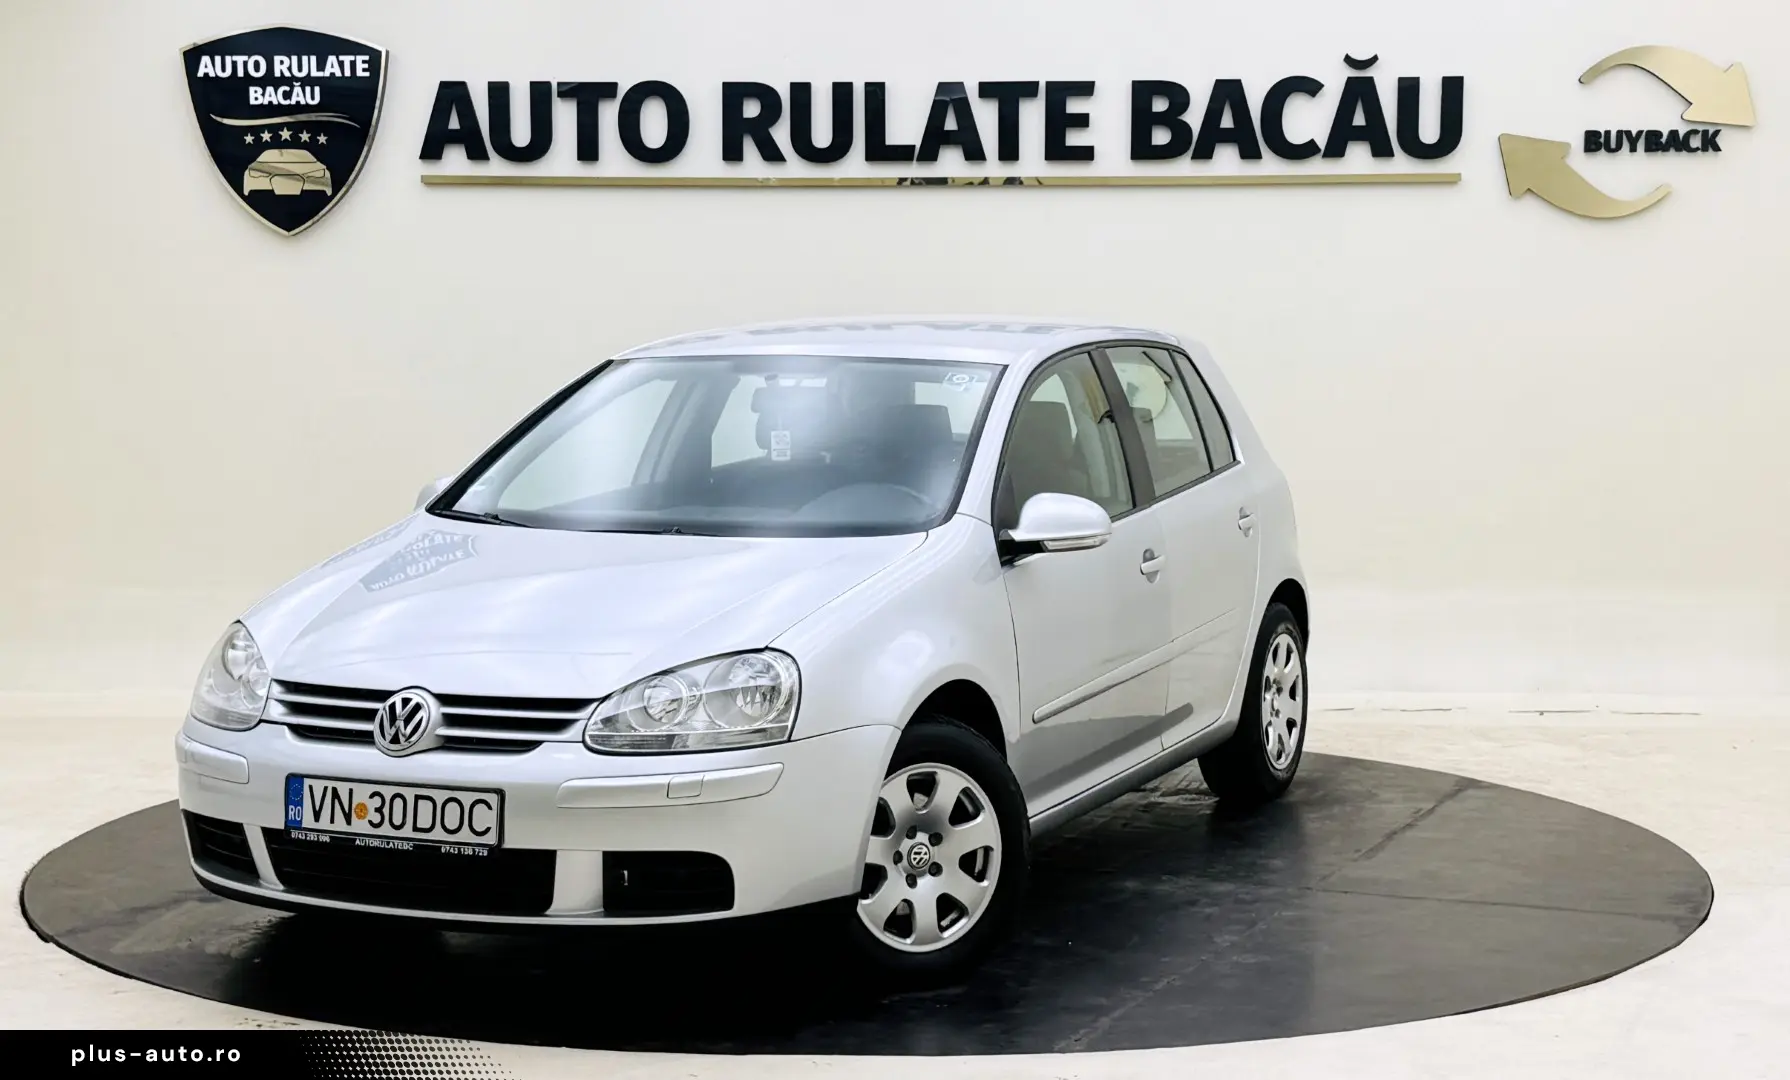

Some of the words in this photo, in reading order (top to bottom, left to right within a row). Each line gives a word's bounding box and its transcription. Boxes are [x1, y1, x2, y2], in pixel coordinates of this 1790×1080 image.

[197, 55, 267, 78] AUTO
[274, 55, 370, 78] RULATE
[249, 81, 321, 105] BACĂU
[418, 80, 690, 164] AUTO
[721, 80, 1096, 164] RULATE
[1130, 52, 1465, 161] BACĂU
[1583, 128, 1722, 154] BUYBACK
[288, 805, 302, 821] RO
